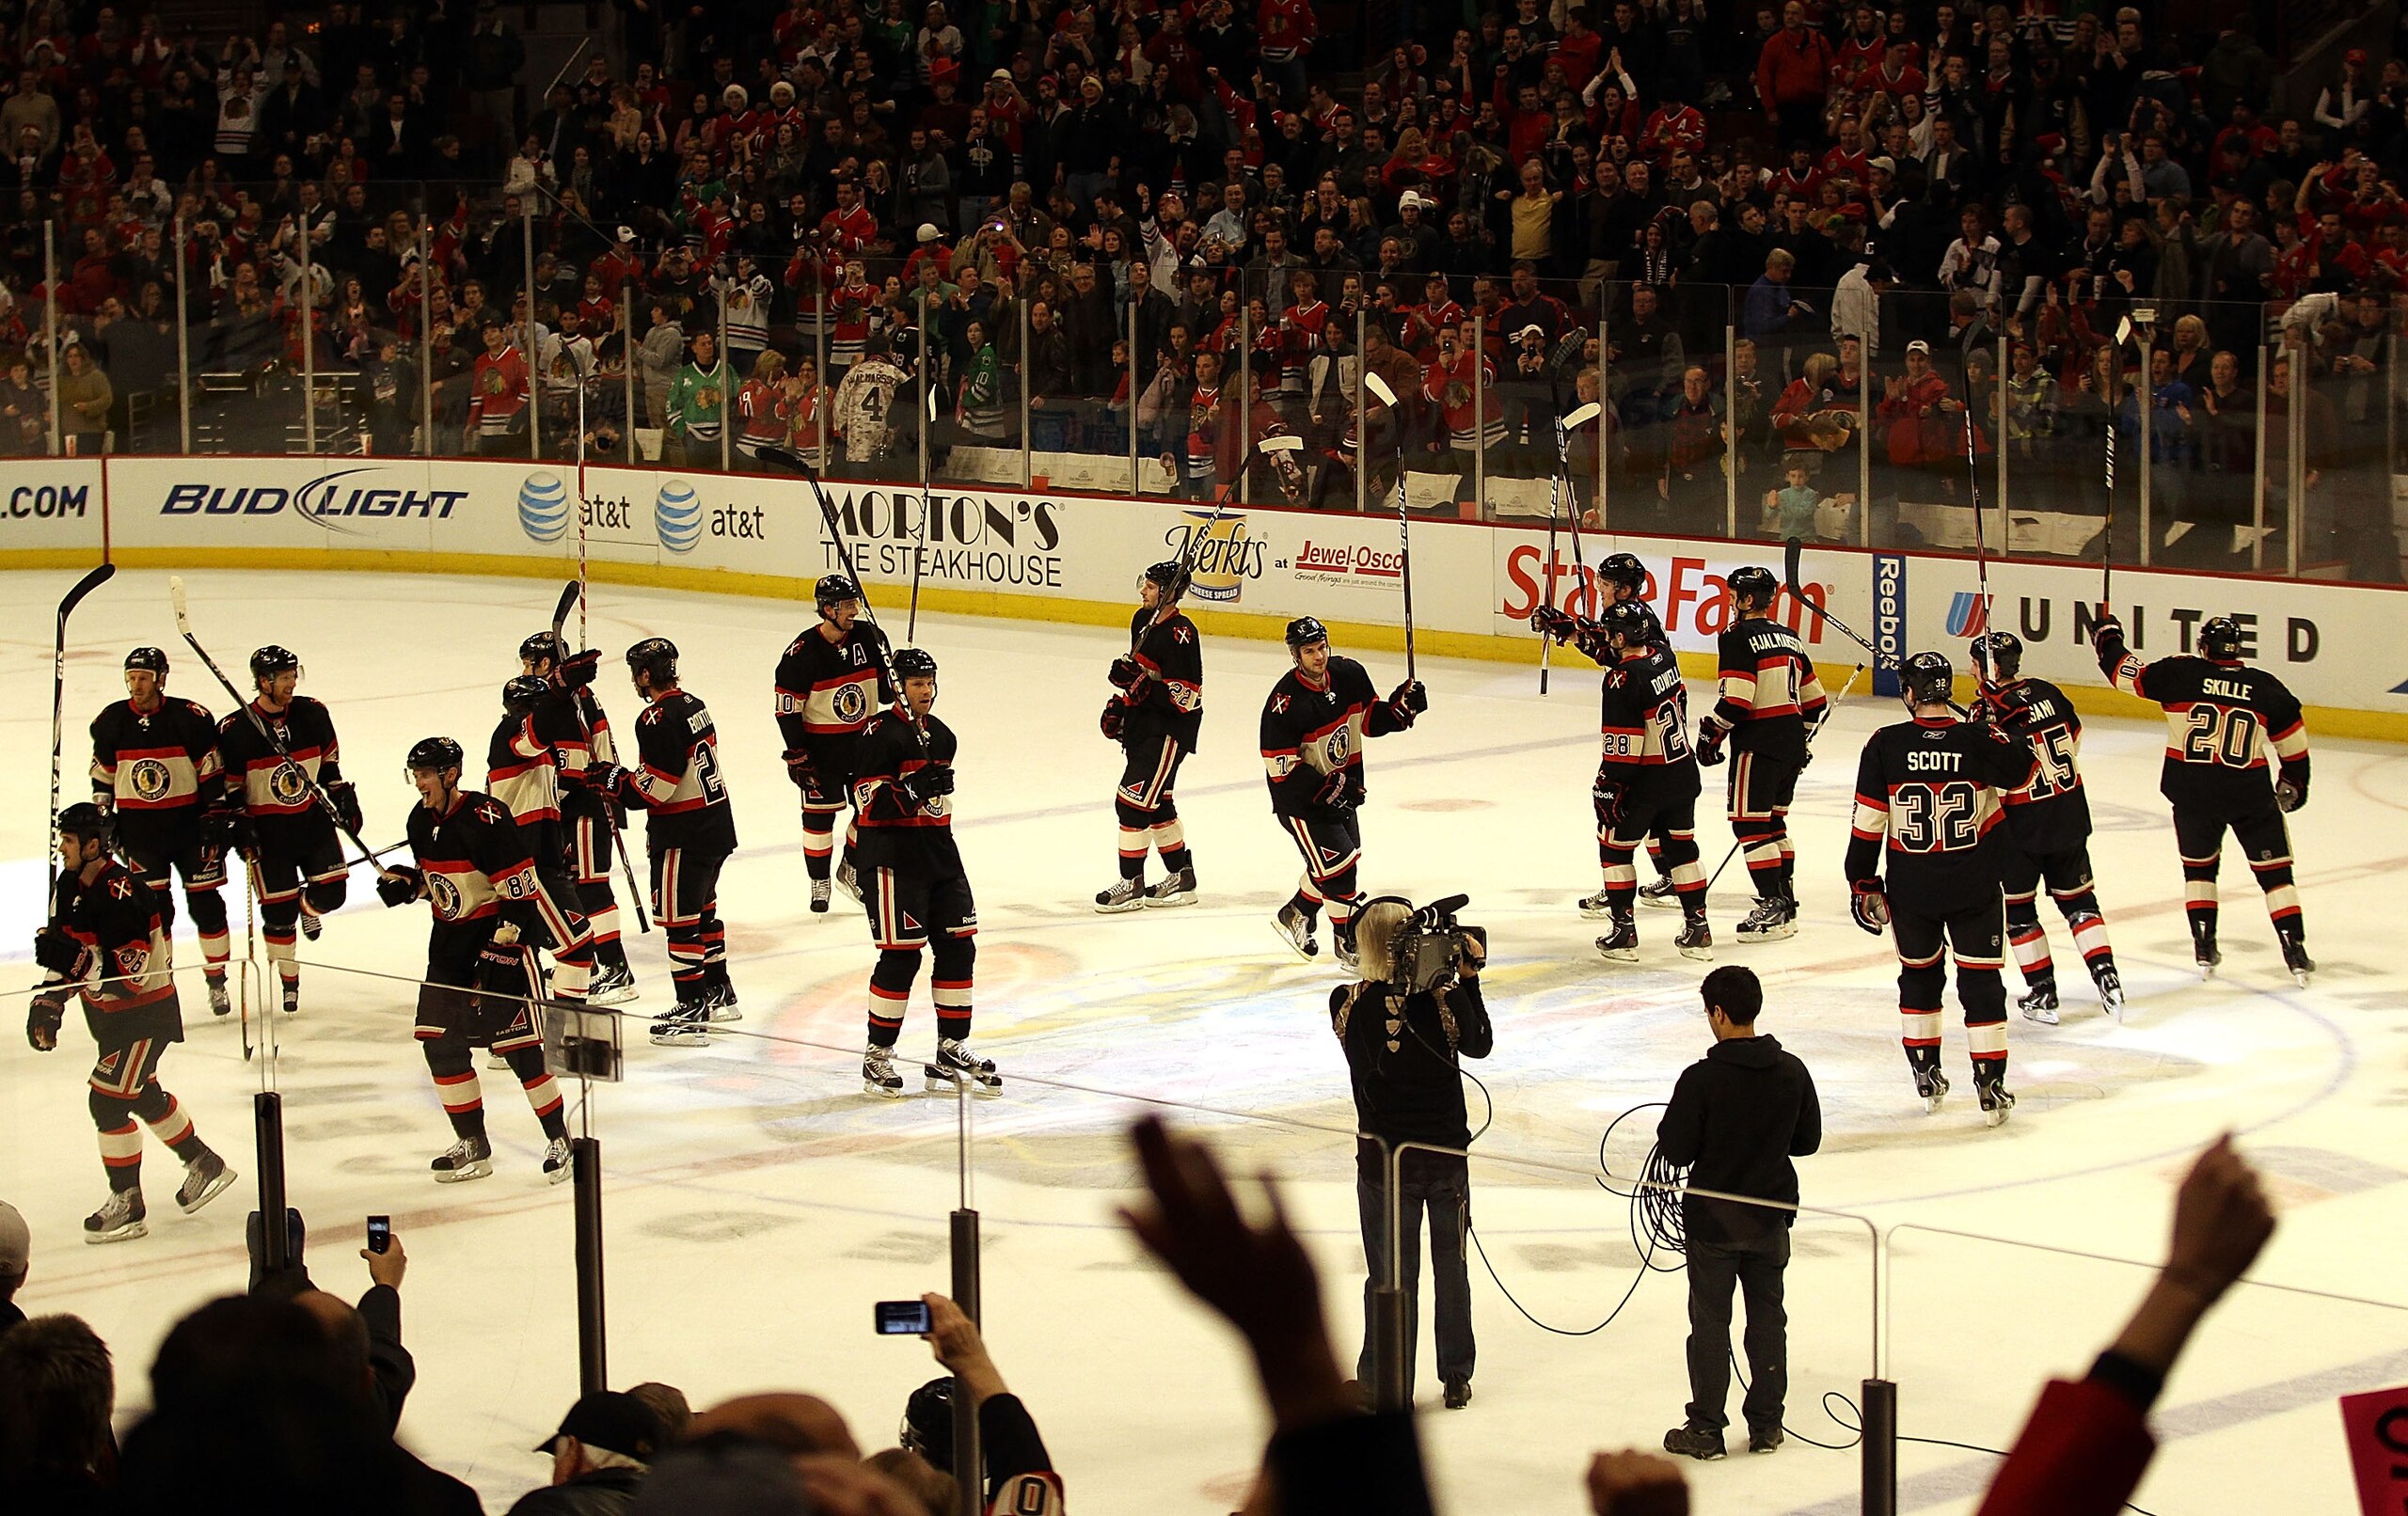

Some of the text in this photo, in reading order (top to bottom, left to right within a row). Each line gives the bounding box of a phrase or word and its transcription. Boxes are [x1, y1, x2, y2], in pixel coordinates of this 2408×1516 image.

[861, 387, 884, 421] 4
[160, 484, 469, 518] BUD LIGHT
[582, 495, 630, 529] at&t
[711, 503, 765, 539] at&t
[820, 489, 1059, 551] MORTON'S
[820, 541, 1062, 588] THE STEAKHOUSE
[1275, 557, 1289, 569] at
[1295, 540, 1404, 570] Jewel-Osco
[1294, 572, 1317, 582] Good
[2020, 596, 2320, 663] UNITED
[853, 643, 866, 666] A
[2202, 677, 2253, 702] SKILLE
[1602, 734, 1630, 756] 28
[2184, 702, 2259, 769] 20
[1907, 751, 1963, 773] SCOTT
[278, 789, 308, 804] CHICAGO
[1895, 780, 1979, 855] 32
